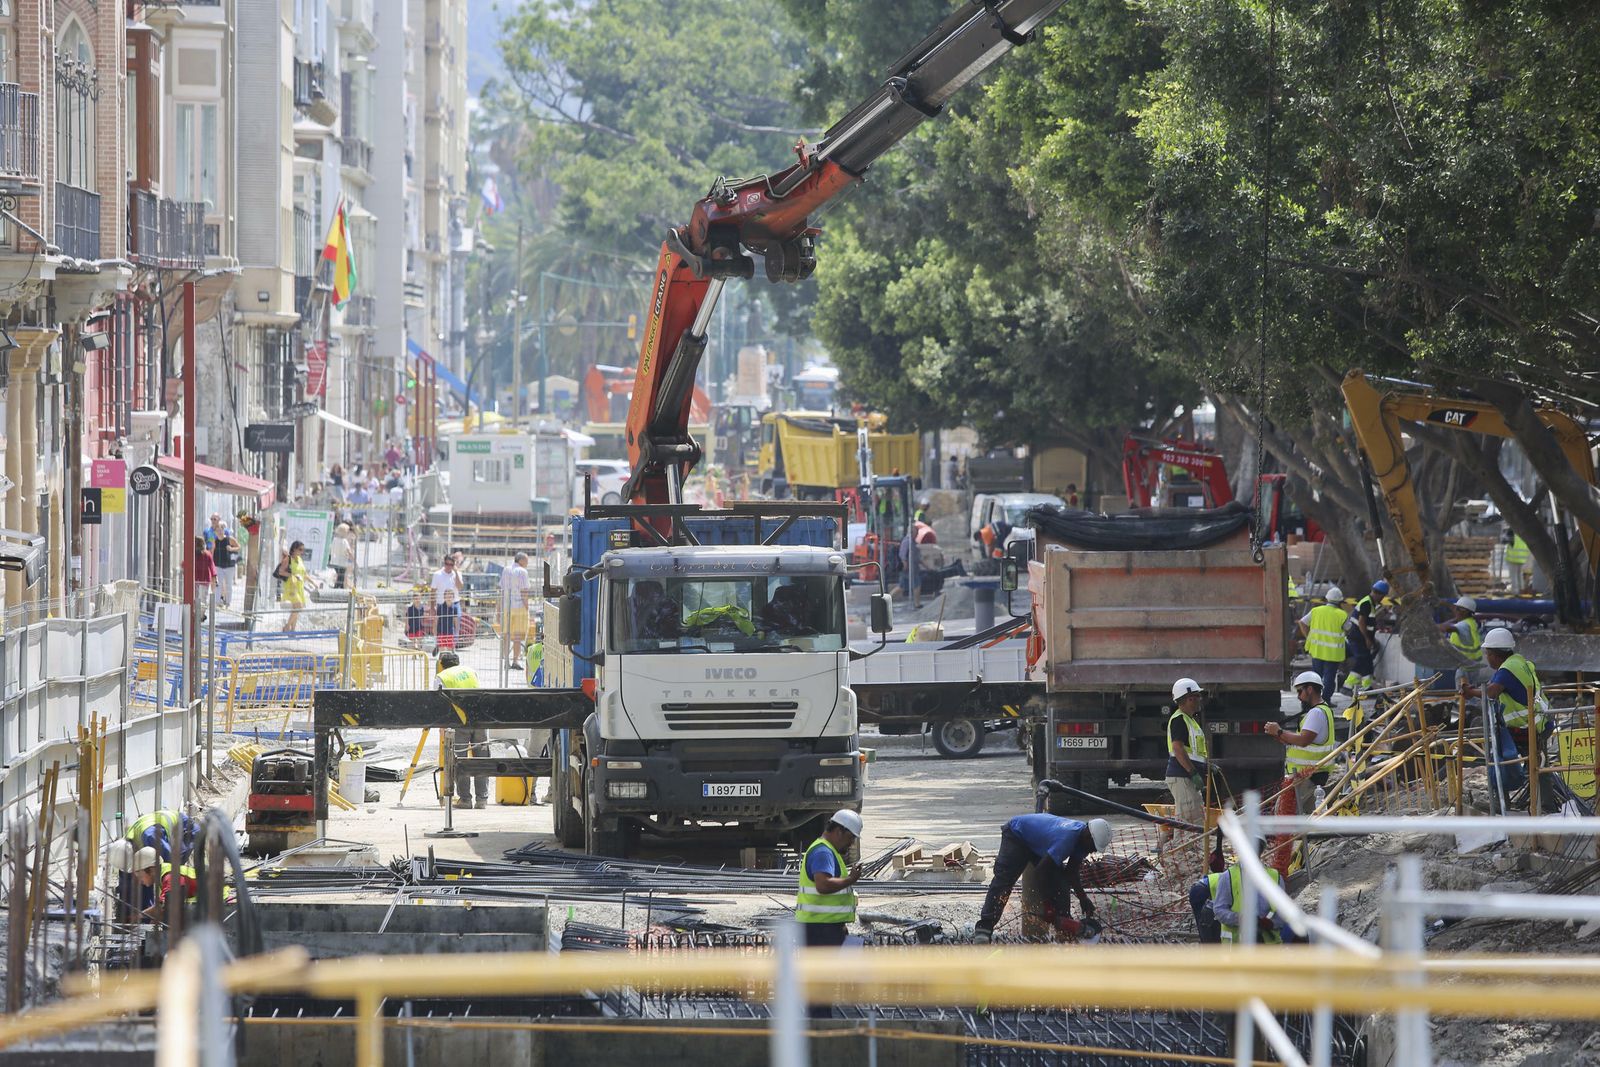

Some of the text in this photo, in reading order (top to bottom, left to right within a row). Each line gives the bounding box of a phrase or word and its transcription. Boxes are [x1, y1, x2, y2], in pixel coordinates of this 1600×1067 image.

[655, 272, 667, 314] CRANE
[1445, 410, 1466, 425] CAT
[705, 667, 758, 680] IVECO
[662, 688, 800, 698] TRAKKER
[1063, 738, 1105, 747] 1669 FDY
[711, 785, 759, 795] 1897 FDN
